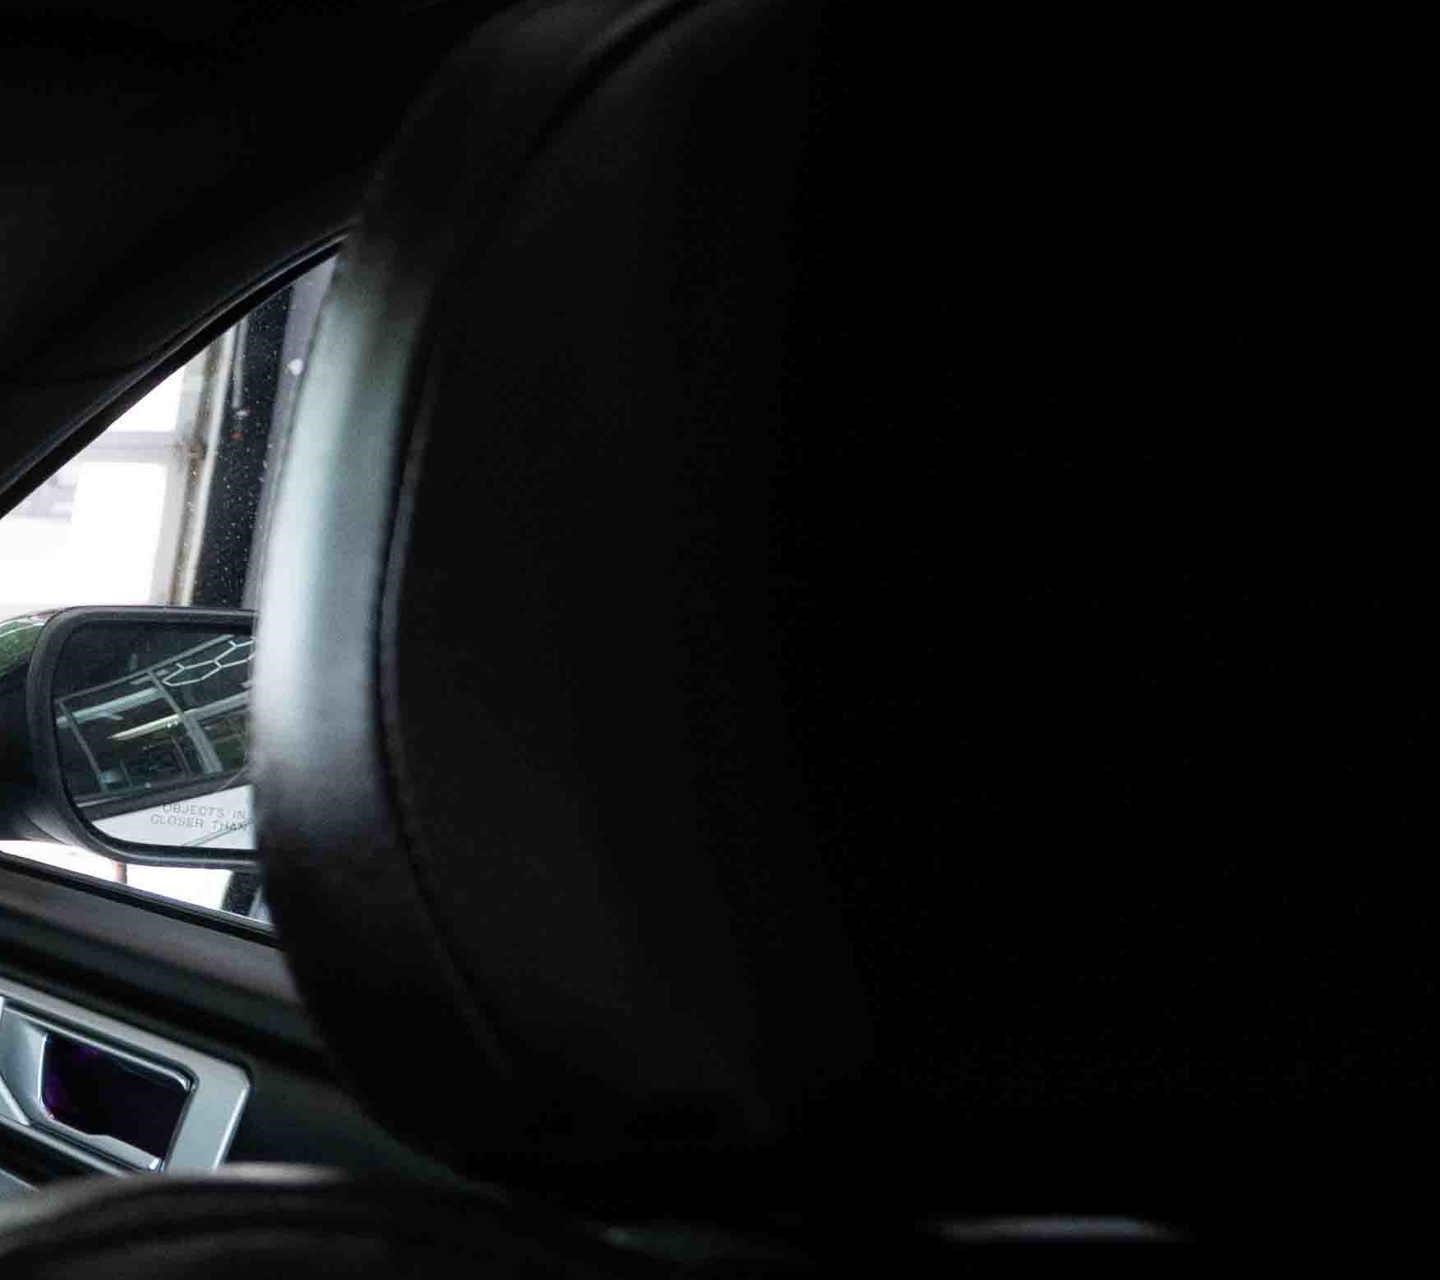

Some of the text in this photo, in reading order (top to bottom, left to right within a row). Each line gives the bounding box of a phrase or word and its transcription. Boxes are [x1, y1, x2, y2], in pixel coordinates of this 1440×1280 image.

[161, 803, 247, 819] OBJECTS IN
[149, 813, 204, 829] CLOSER
